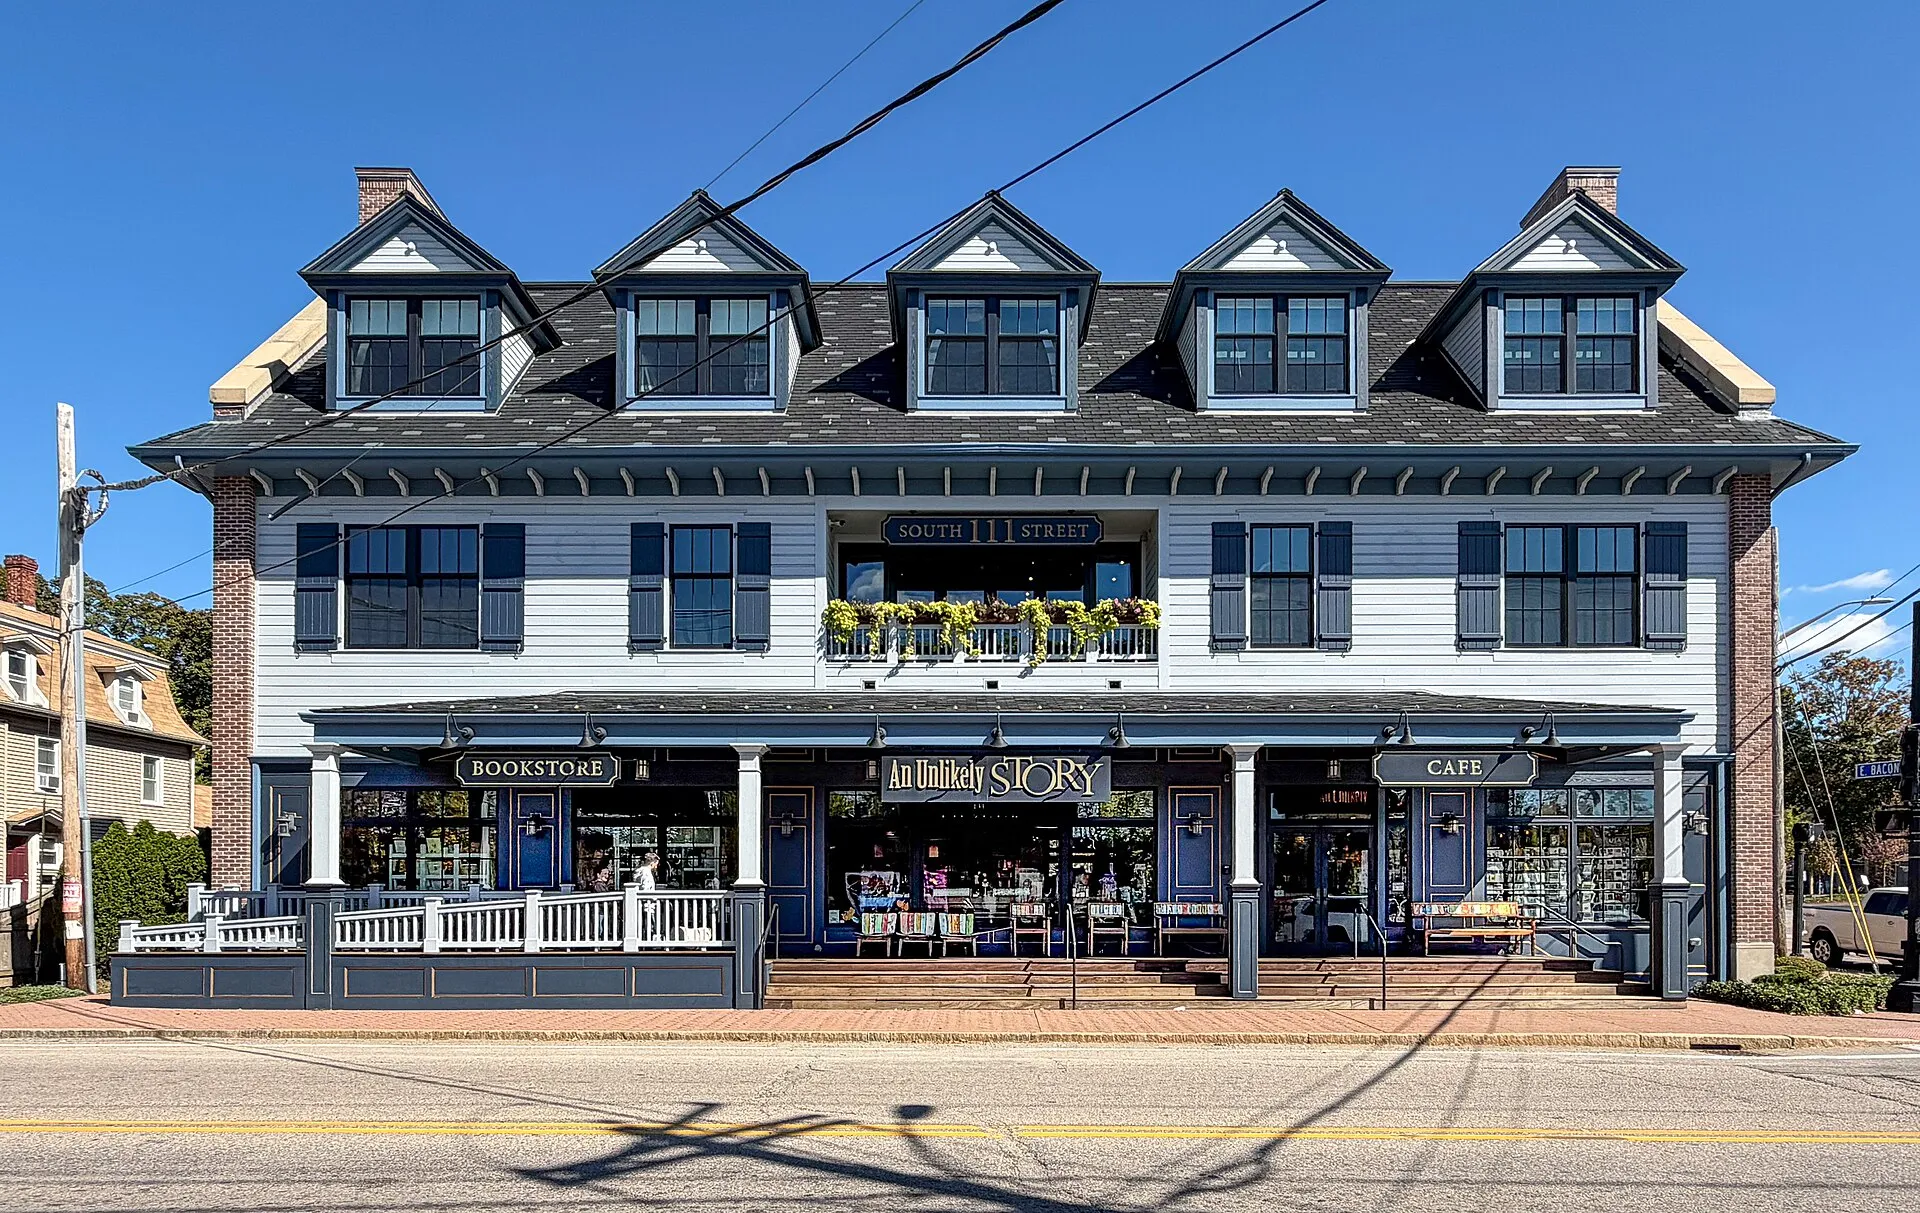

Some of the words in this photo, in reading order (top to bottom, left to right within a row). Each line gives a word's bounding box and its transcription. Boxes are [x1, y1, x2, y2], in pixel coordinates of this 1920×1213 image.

[899, 524, 962, 538] SOUTH
[969, 519, 1016, 543] 111
[1021, 524, 1089, 538] STREET
[472, 760, 603, 776] BOOKSTORE
[1427, 759, 1483, 776] CAFE
[1859, 766, 1867, 776] E.
[1870, 763, 1900, 775] BACON
[888, 759, 913, 789] An
[915, 759, 985, 794] Unlikely
[990, 756, 1104, 797] STORY
